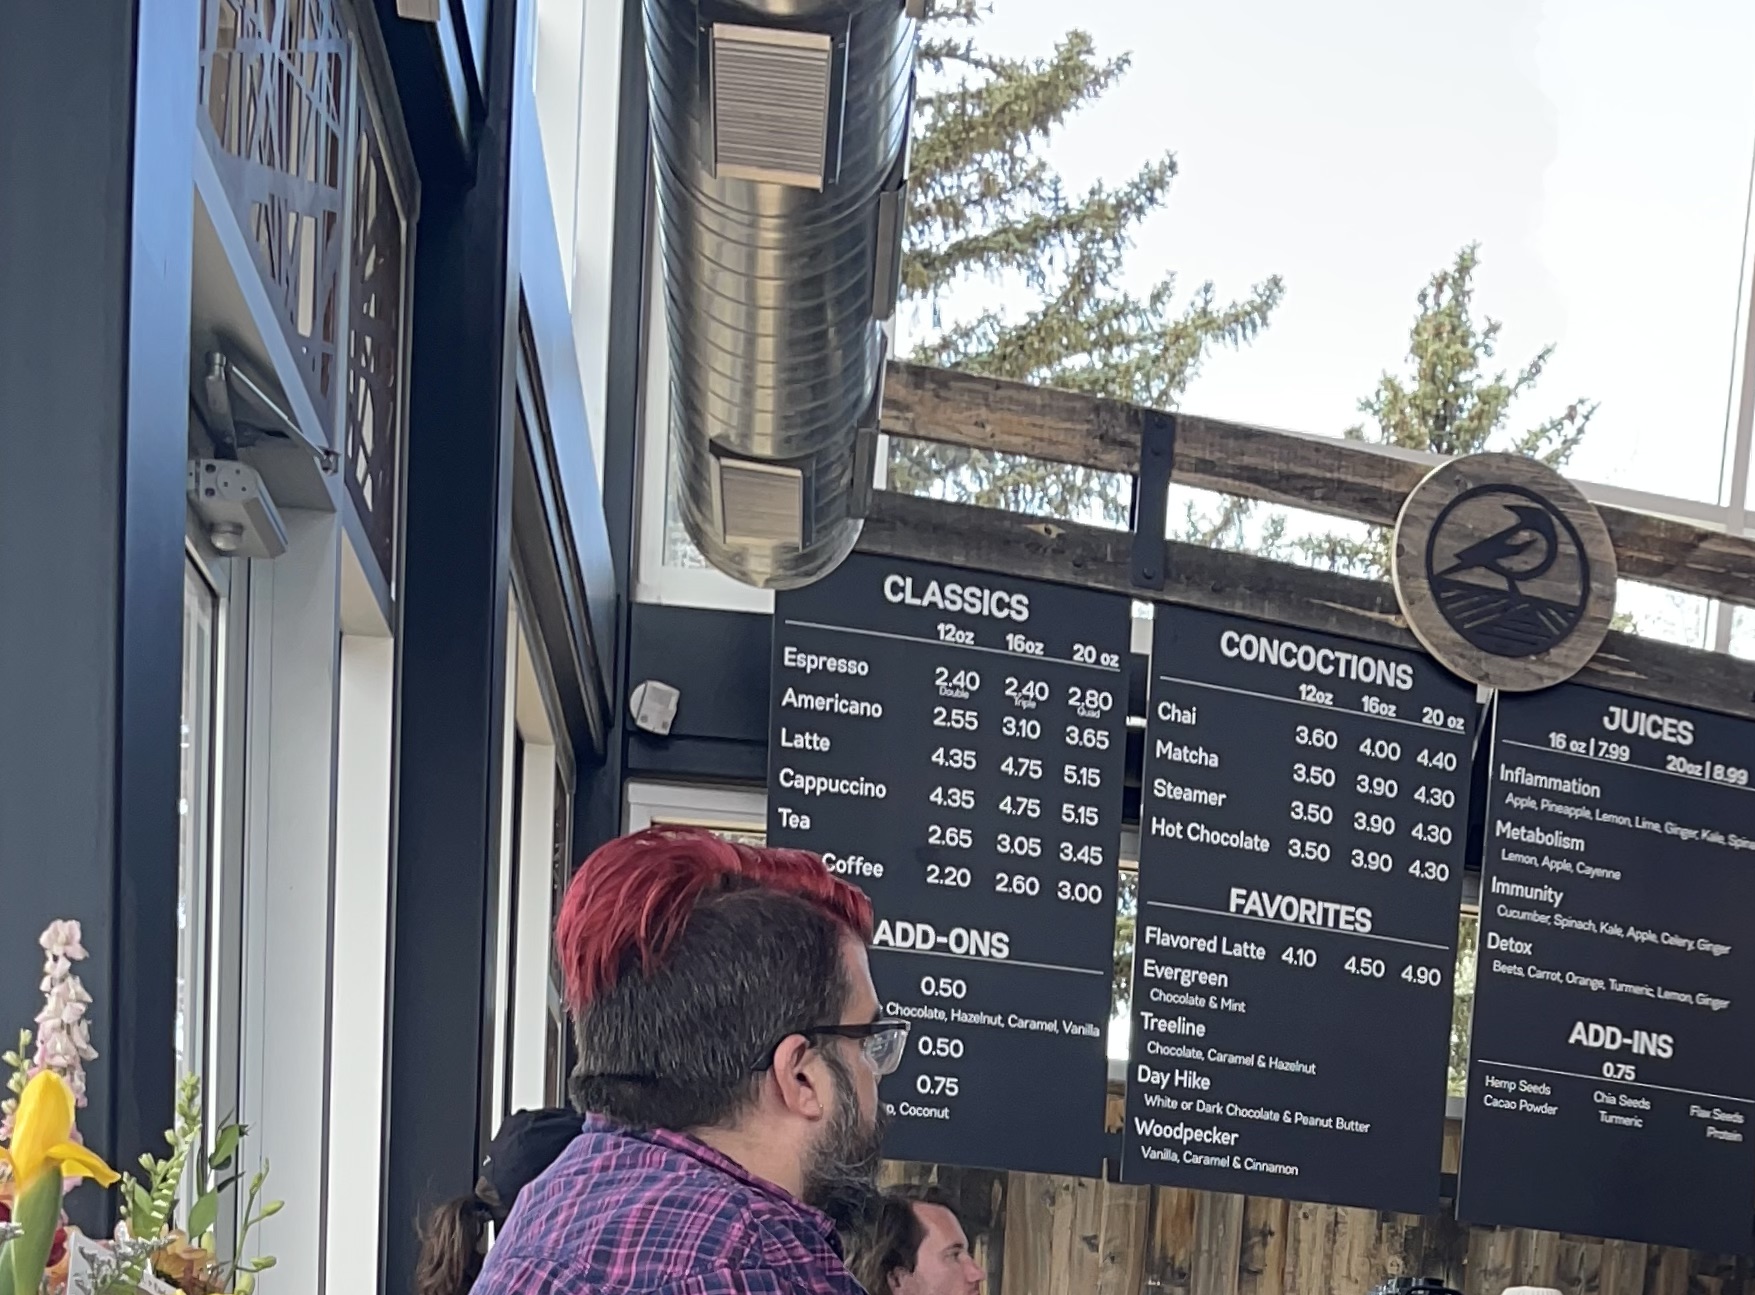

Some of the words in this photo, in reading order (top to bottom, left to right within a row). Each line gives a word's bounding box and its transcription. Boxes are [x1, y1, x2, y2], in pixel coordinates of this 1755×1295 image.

[884, 574, 1029, 621] CLASSICS
[937, 623, 975, 646] 12oz
[1005, 633, 1044, 656] 16oz
[1072, 643, 1096, 664] 20
[1100, 653, 1120, 668] oz
[1220, 630, 1414, 690] CONCOCTIONS
[783, 647, 869, 676] Espresso
[935, 667, 980, 692] 2.40
[1004, 677, 1049, 701] 2.40
[1068, 687, 1112, 711] 2.80
[781, 688, 883, 718] Americano
[933, 707, 978, 730] 2.55
[1002, 716, 1041, 740] 3.10
[1066, 726, 1109, 749] 3.65
[1299, 684, 1333, 705] 12oz
[1362, 695, 1396, 717] 16oz
[1422, 707, 1443, 726] 20
[1447, 716, 1464, 730] oz
[1157, 702, 1197, 725] Chai
[1296, 726, 1338, 750] 3.60
[1359, 738, 1401, 761] 4.00
[1417, 749, 1457, 771] 4.40
[1603, 706, 1694, 746] JUICES
[781, 728, 830, 752] Latte
[931, 747, 977, 770] 4.35
[1001, 757, 1043, 779] 4.75
[1064, 765, 1101, 788] 5.15
[1549, 732, 1566, 749] 16
[1569, 740, 1586, 753] oz
[1598, 741, 1630, 761] 7.99
[1155, 739, 1219, 768] Matcha
[1293, 763, 1336, 787] 3.50
[1356, 774, 1398, 799] 3.90
[1414, 786, 1455, 808] 4.30
[1500, 763, 1601, 798] Inflammation
[1666, 754, 1702, 776] 20oz
[1713, 765, 1748, 785] 8.99
[779, 769, 886, 799] Cappuccino
[929, 787, 975, 810] 4.35
[999, 796, 1041, 819] 4.75
[1062, 804, 1098, 826] 5.15
[1153, 778, 1227, 807] Steamer
[1290, 801, 1333, 824] 3.50
[1354, 812, 1395, 835] 3.90
[1411, 823, 1452, 845] 4.30
[778, 808, 811, 830] Tea
[928, 825, 973, 848] 2.65
[997, 834, 1041, 857] 3.05
[1060, 843, 1103, 866] 3.45
[1151, 817, 1183, 839] Hot
[1186, 823, 1270, 852] Chocolate
[1288, 839, 1330, 862] 3.50
[1351, 849, 1393, 872] 3.90
[1409, 859, 1449, 881] 4.30
[1496, 820, 1585, 852] Metabolism
[821, 853, 884, 878] Coffee
[926, 865, 971, 887] 2.20
[996, 873, 1040, 895] 2.60
[1057, 881, 1102, 904] 3.00
[1576, 862, 1621, 880] Cayenne
[1491, 876, 1563, 908] Immunity
[1229, 887, 1372, 933] FAVORITES
[873, 920, 1009, 959] ADD-ONS
[1487, 932, 1532, 955] Detox
[1697, 939, 1731, 956] Ginger
[1145, 926, 1217, 953] Flavored
[1222, 937, 1266, 961] Latte
[1281, 946, 1317, 968] 4.10
[1344, 956, 1385, 977] 4.50
[1401, 965, 1441, 986] 4.90
[921, 976, 967, 999] 0.50
[1143, 959, 1229, 988] Evergreen
[1150, 988, 1206, 1007] Chocolate
[1209, 996, 1218, 1010] &
[1221, 998, 1246, 1013] Mint
[1696, 994, 1730, 1011] Ginger
[1062, 1021, 1100, 1038] Vanilla
[1141, 1012, 1206, 1038] Treeline
[1568, 1021, 1674, 1059] ADD-INS
[918, 1036, 964, 1059] 0.50
[1207, 1049, 1254, 1066] Caramel
[1257, 1055, 1266, 1068] &
[1269, 1057, 1316, 1075] Hazelnut
[916, 1075, 959, 1097] 0.75
[1137, 1065, 1170, 1090] Day
[1174, 1071, 1211, 1090] Hike
[1485, 1075, 1516, 1093] Hemp
[1519, 1080, 1551, 1096] Seeds
[1603, 1062, 1636, 1081] 0.75
[900, 1103, 950, 1119] Coconut
[1144, 1093, 1178, 1110] White
[1181, 1101, 1193, 1111] or
[1196, 1101, 1223, 1115] Dark
[1226, 1104, 1280, 1122] Chocolate
[1283, 1111, 1291, 1123] &
[1294, 1112, 1333, 1129] Peanut
[1336, 1118, 1370, 1133] Butter
[1484, 1095, 1516, 1110] Cacao
[1519, 1100, 1558, 1116] Powder
[1594, 1091, 1616, 1106] Chia
[1619, 1095, 1651, 1110] Seeds
[1135, 1117, 1239, 1146] Woodpecker
[1599, 1110, 1643, 1128] Turmeric
[1713, 1109, 1744, 1124] Seeds
[1183, 1151, 1230, 1168] Caramel
[1232, 1157, 1241, 1169] &
[1244, 1158, 1298, 1175] Cinnamon
